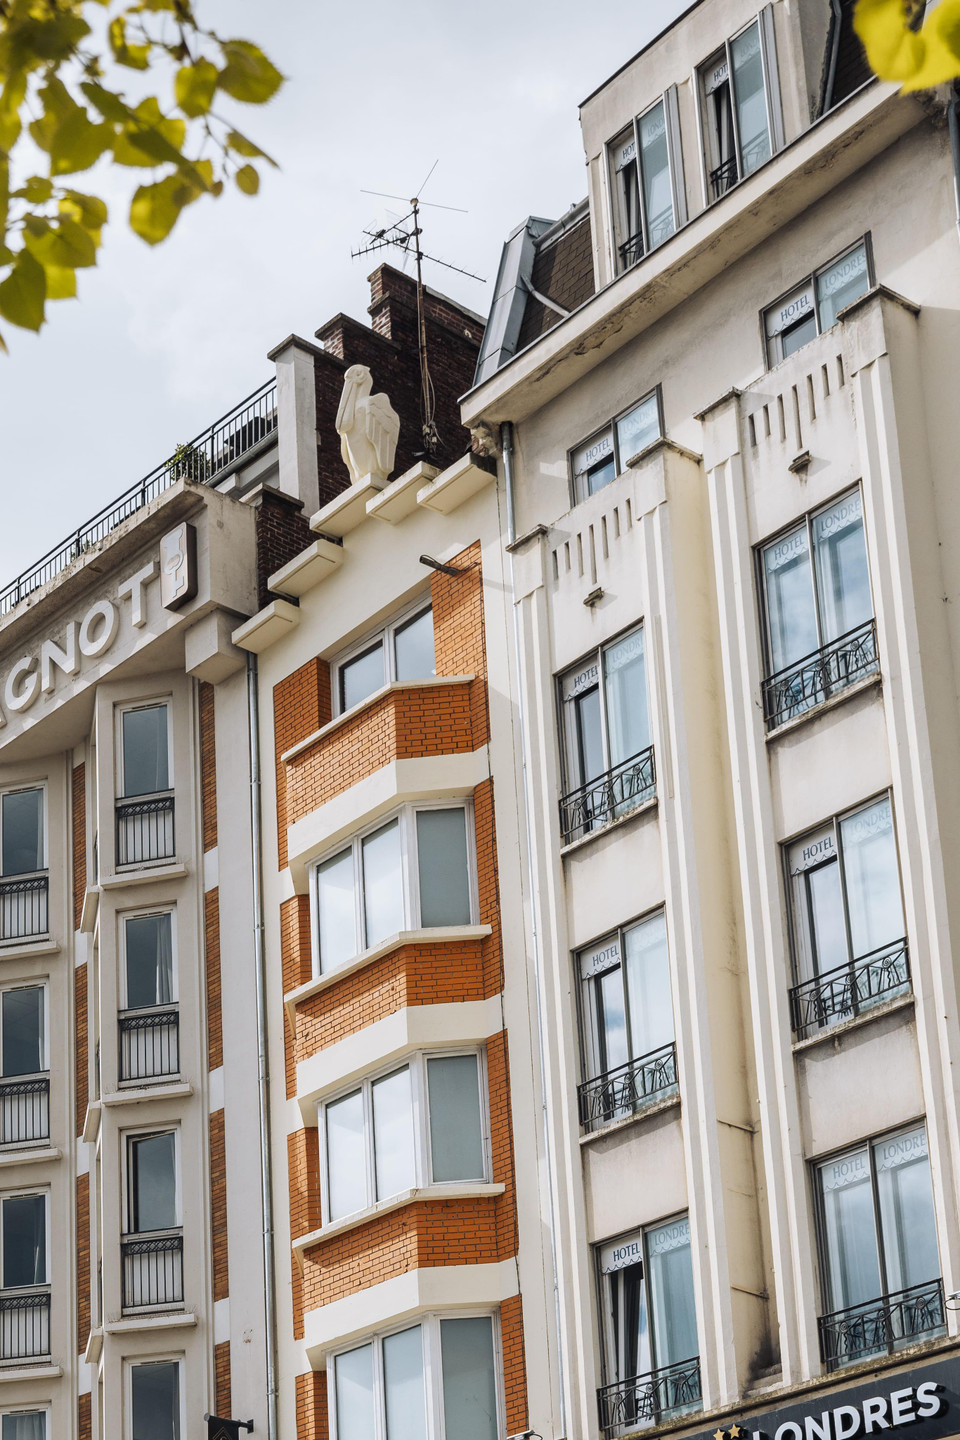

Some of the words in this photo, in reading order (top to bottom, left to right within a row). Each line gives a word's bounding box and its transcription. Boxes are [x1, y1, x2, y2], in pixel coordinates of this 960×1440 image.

[622, 141, 636, 159] HOT
[781, 295, 809, 321] HOTEL
[586, 438, 610, 462] HOTEL
[774, 534, 804, 561] HOTEL
[821, 500, 861, 532] LONDRE
[802, 836, 834, 861] HOTEL
[592, 945, 620, 967] HOTEL
[833, 1157, 866, 1180] HOTEL
[883, 1133, 925, 1161] LONDRE
[613, 1242, 641, 1262] HOTEL
[654, 1222, 690, 1246] LONDRE
